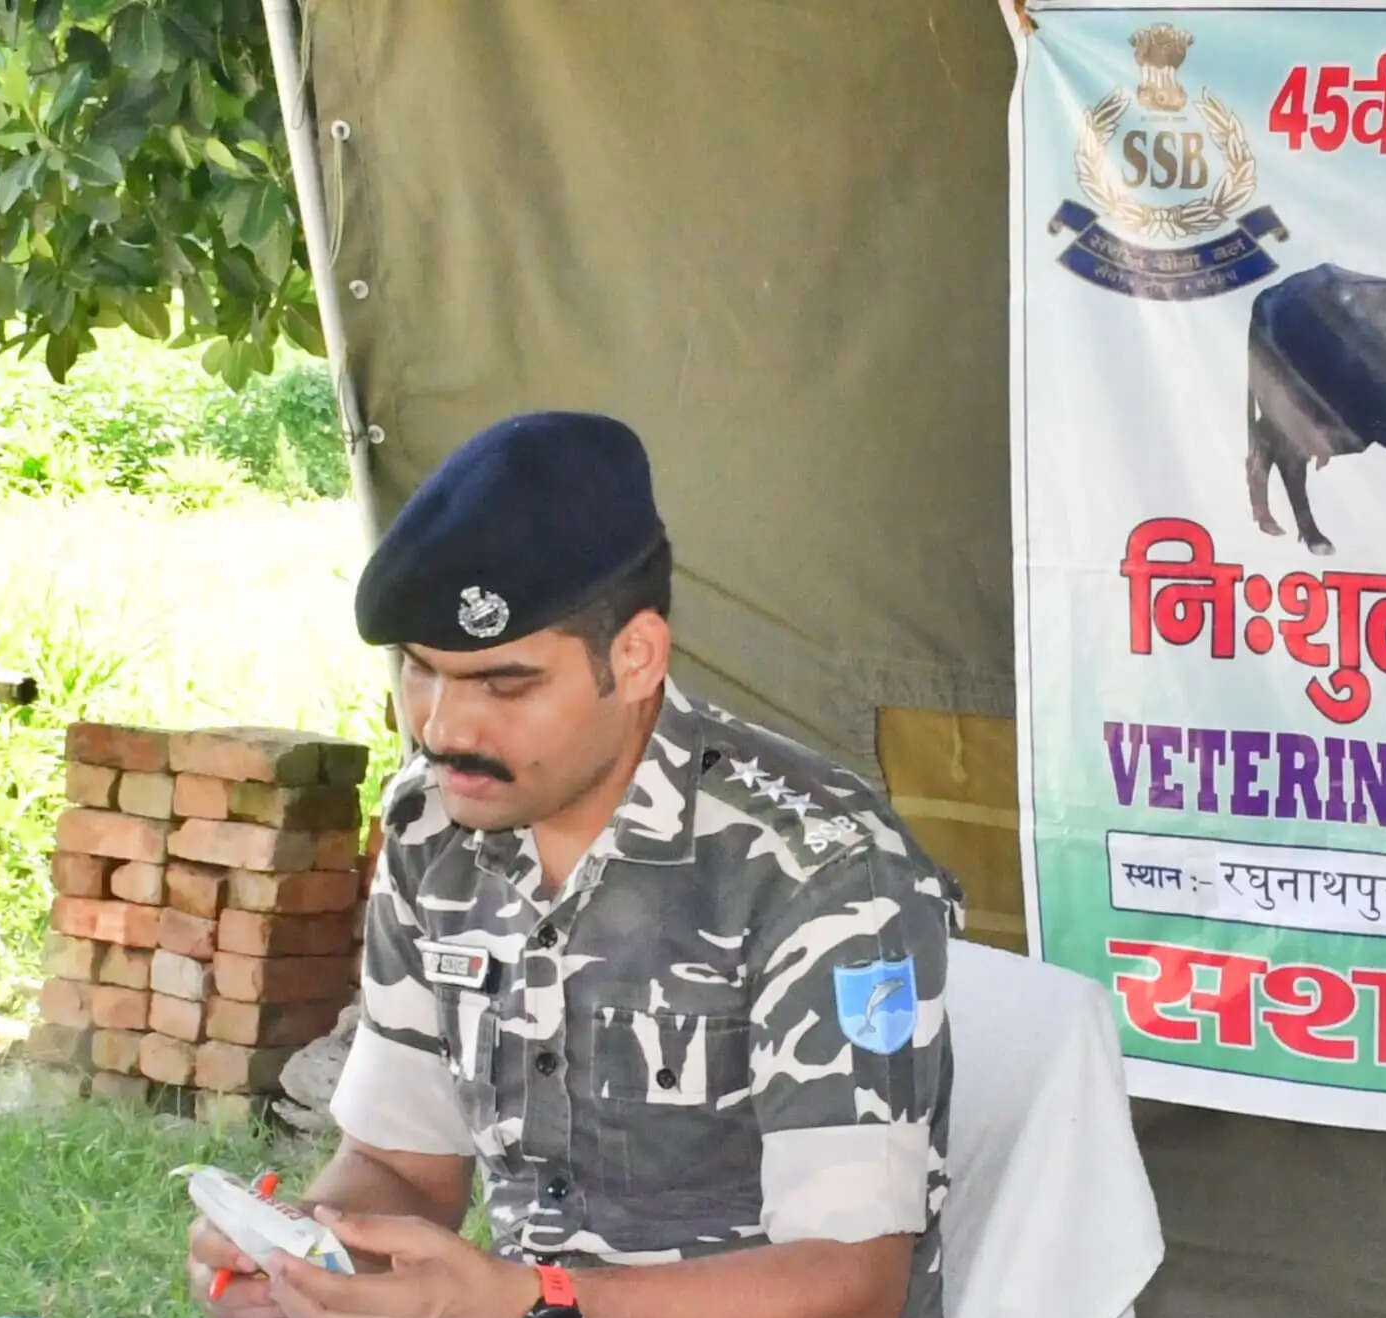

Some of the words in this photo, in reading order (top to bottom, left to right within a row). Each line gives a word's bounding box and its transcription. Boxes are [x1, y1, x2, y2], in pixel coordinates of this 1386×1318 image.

[1122, 129, 1209, 190] SSB
[803, 814, 858, 855] SSB
[1121, 861, 1184, 894] स्थान
